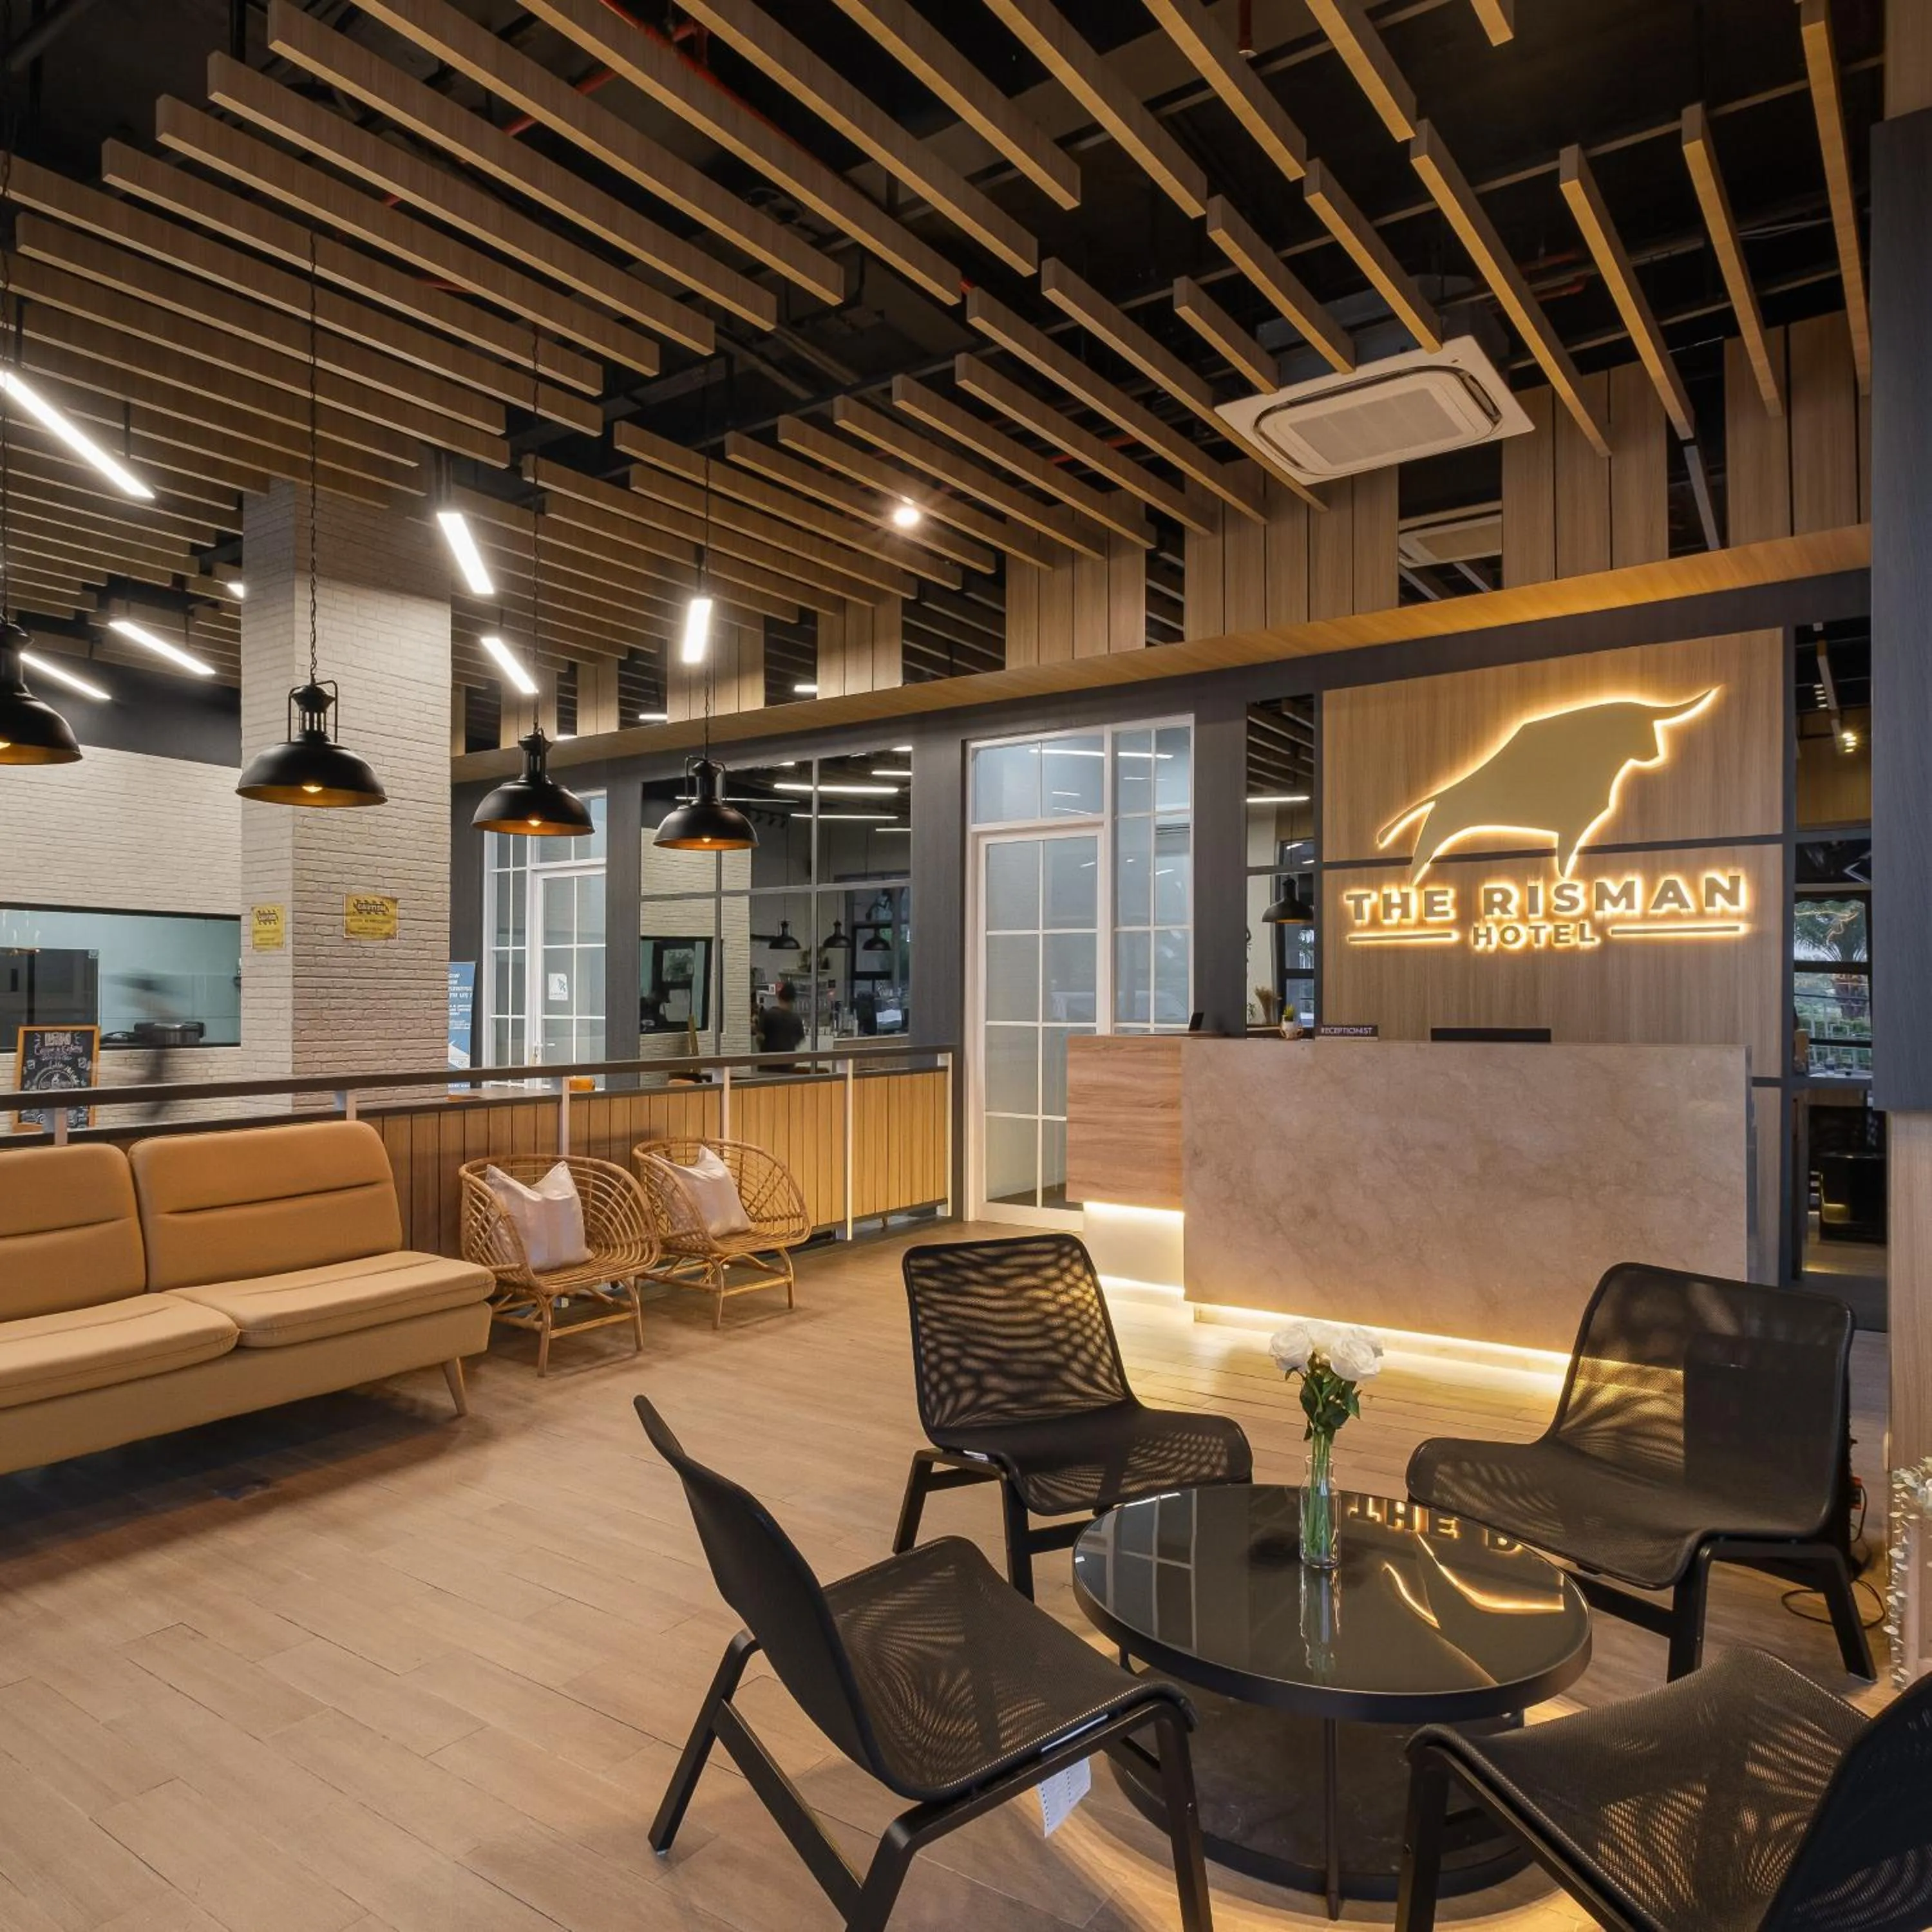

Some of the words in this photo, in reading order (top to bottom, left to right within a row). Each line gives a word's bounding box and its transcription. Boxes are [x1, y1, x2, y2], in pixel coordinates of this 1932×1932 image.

[1345, 887, 1454, 921] THE
[1482, 875, 1743, 917] RISMAN
[1472, 923, 1597, 947] HOTEL
